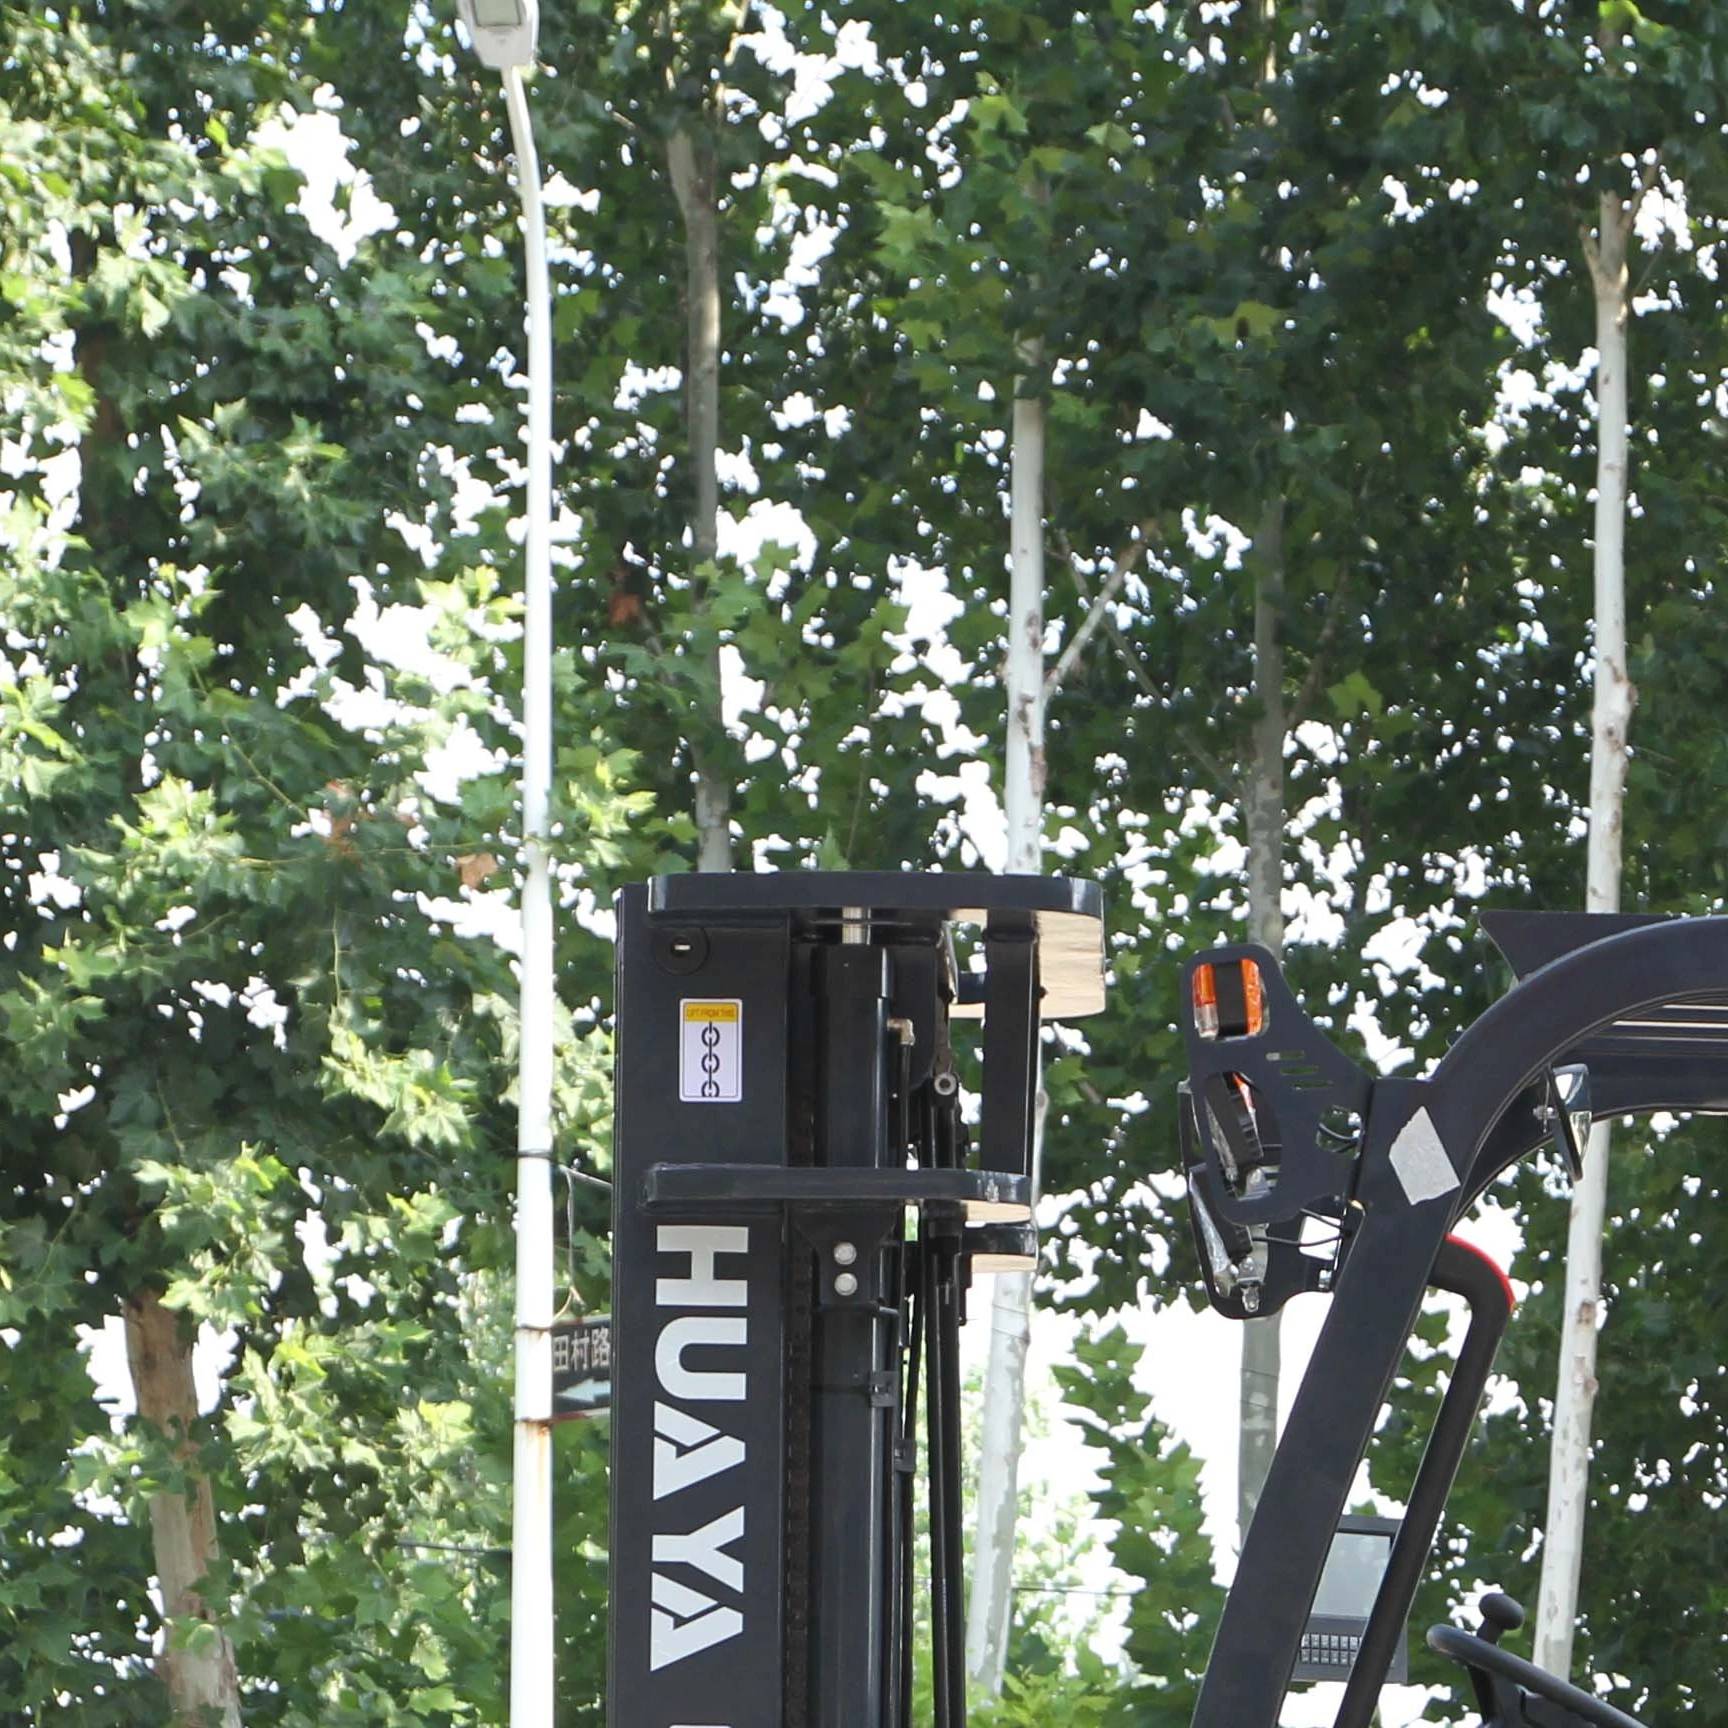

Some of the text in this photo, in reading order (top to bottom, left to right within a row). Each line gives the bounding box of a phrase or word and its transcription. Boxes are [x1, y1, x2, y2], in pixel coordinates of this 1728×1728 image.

[553, 1327, 610, 1372] 田村路
[650, 1225, 749, 1672] HUAYA
